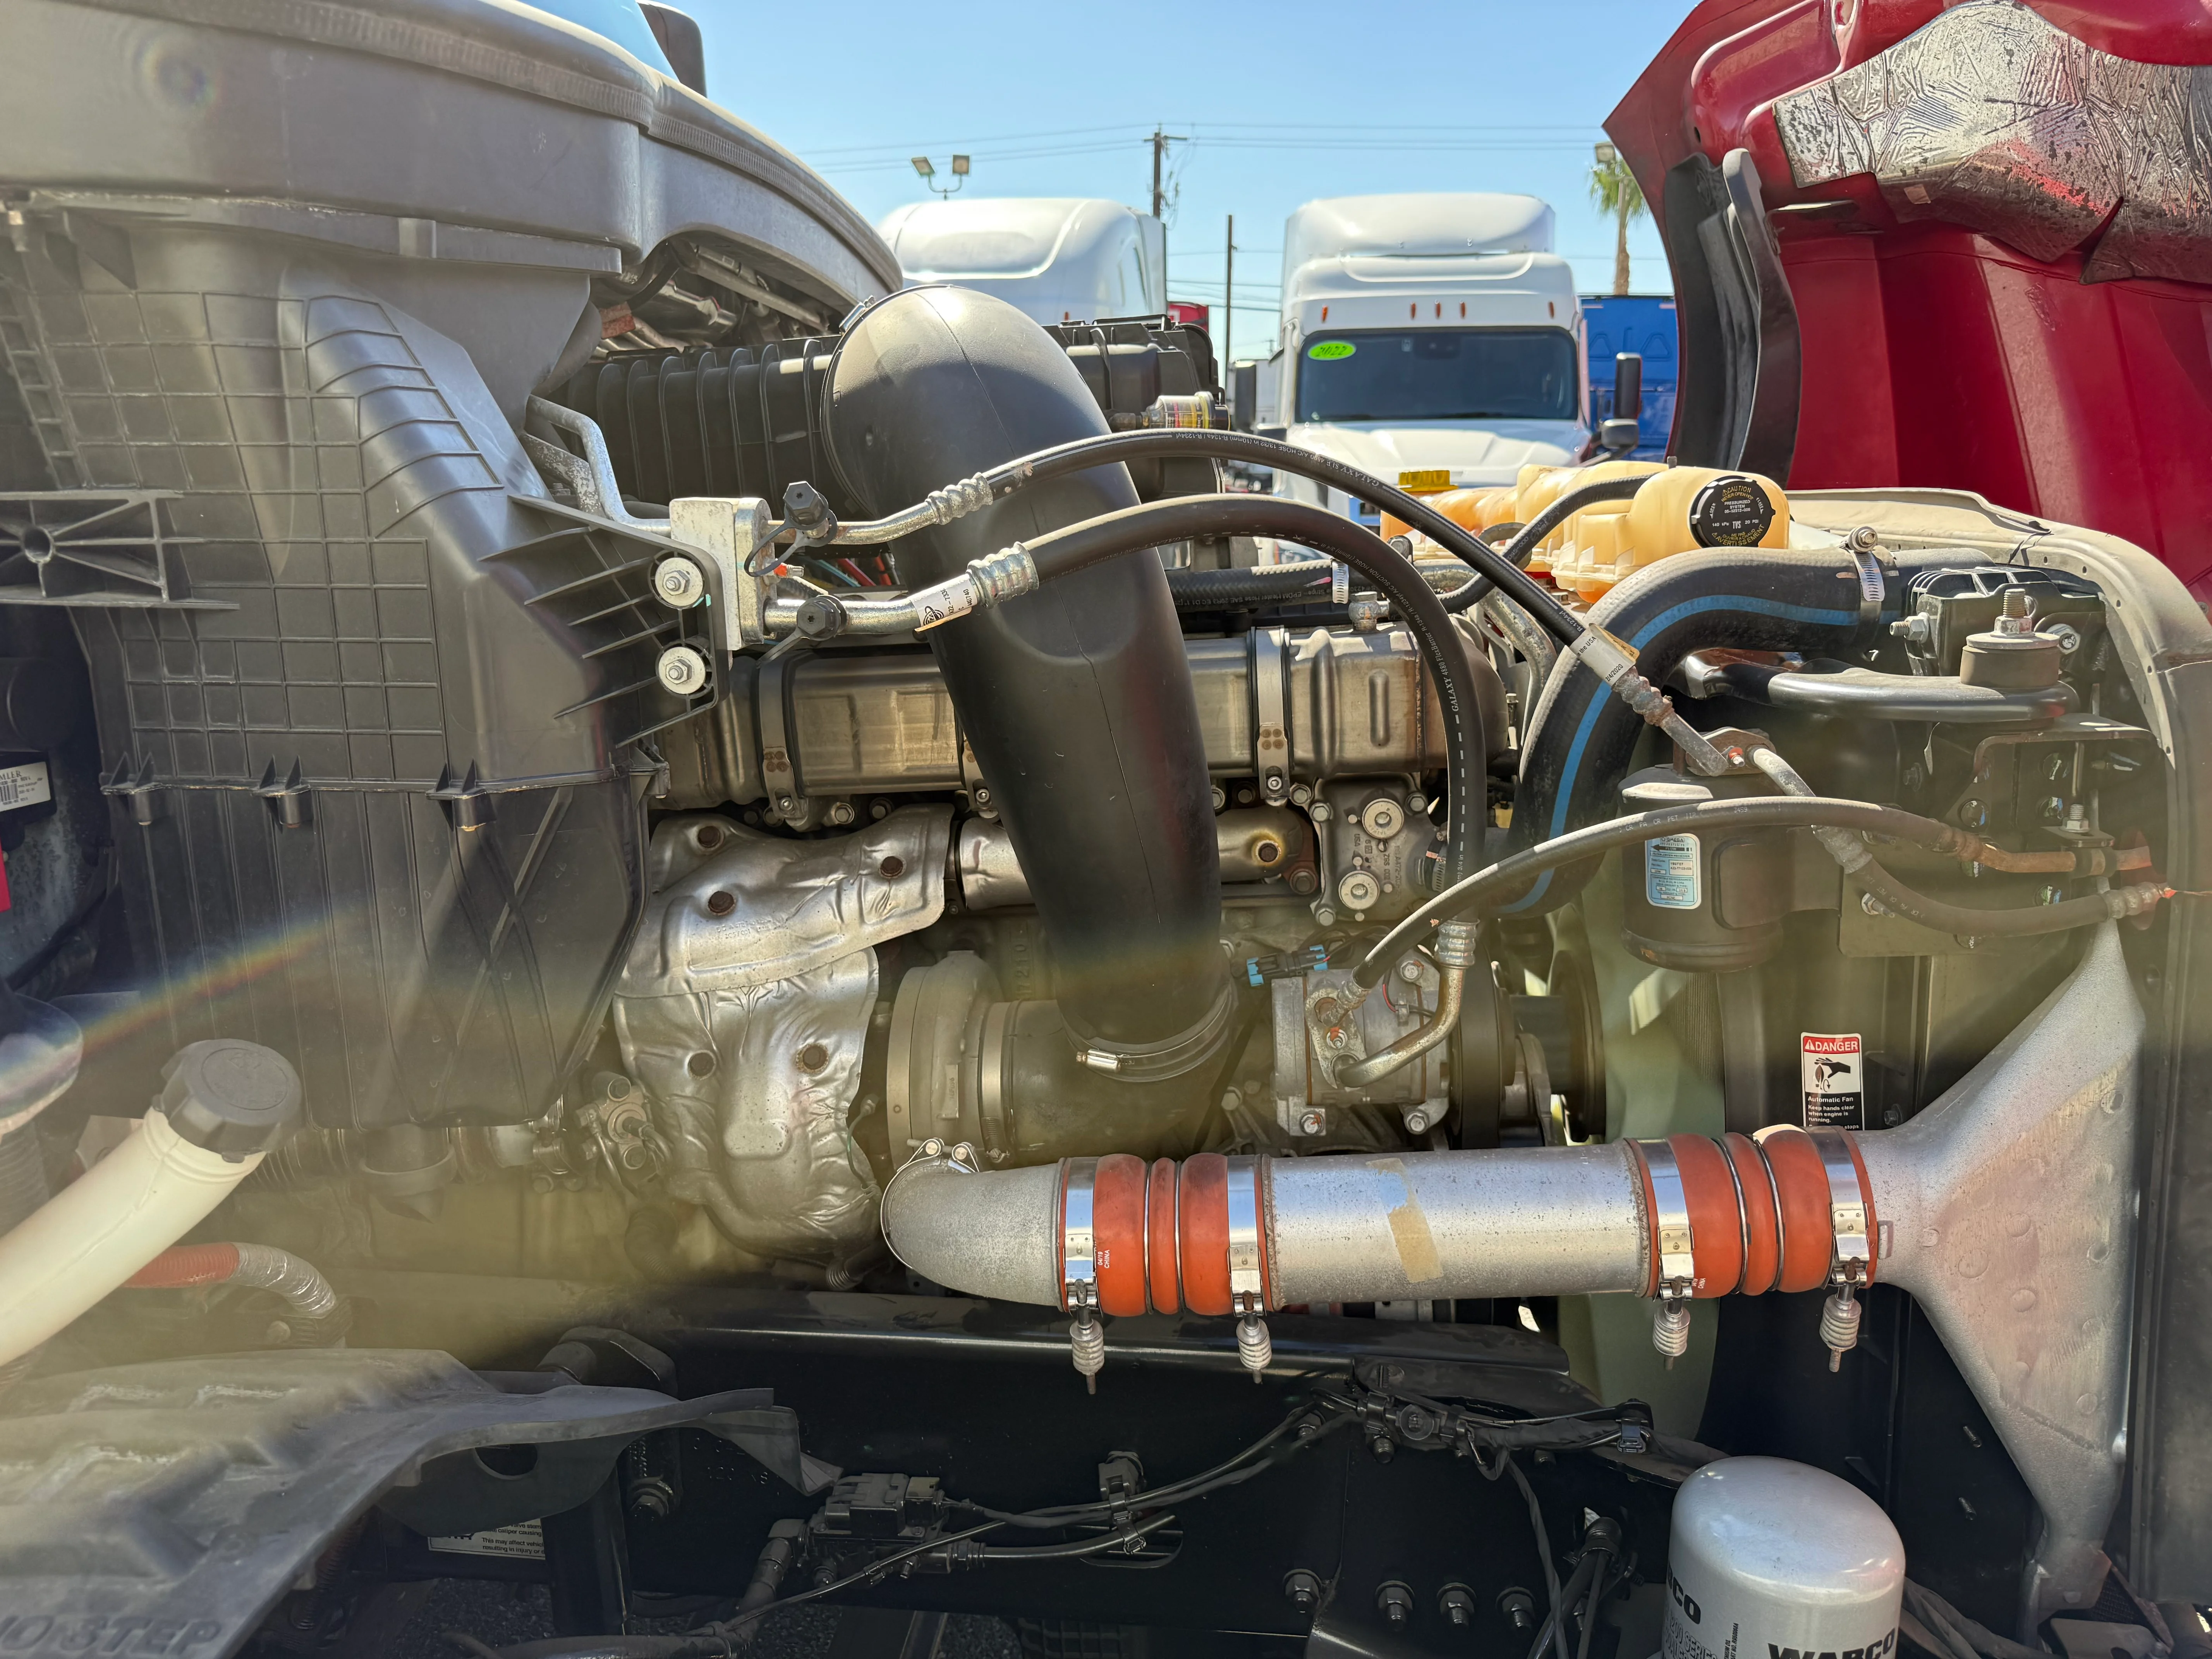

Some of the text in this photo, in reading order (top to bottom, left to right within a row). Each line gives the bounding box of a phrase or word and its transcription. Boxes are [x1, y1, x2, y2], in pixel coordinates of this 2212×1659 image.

[1230, 435, 1252, 444] (10mm)
[1260, 440, 1276, 449] 13/32
[1278, 445, 1296, 454] HOSE
[1340, 467, 1379, 486] GALAXY
[1732, 520, 1741, 529] TVS
[1716, 524, 1765, 546] AVERTISSEMENT
[1355, 559, 1370, 570] HOSE
[1368, 568, 1390, 586] SUCTION
[1389, 585, 1397, 594] A/C
[1396, 592, 1413, 613] R-1234yf
[1414, 612, 1427, 632] R-134a
[1559, 610, 1583, 632] R-1234yf
[1425, 632, 1444, 662] FlexBarrier
[1585, 636, 1597, 646] USA
[1438, 662, 1448, 675] 4880
[1443, 677, 1459, 712] GALAXY
[1815, 1041, 1858, 1052] DANGER
[1697, 1278, 1706, 1289] CHINA
